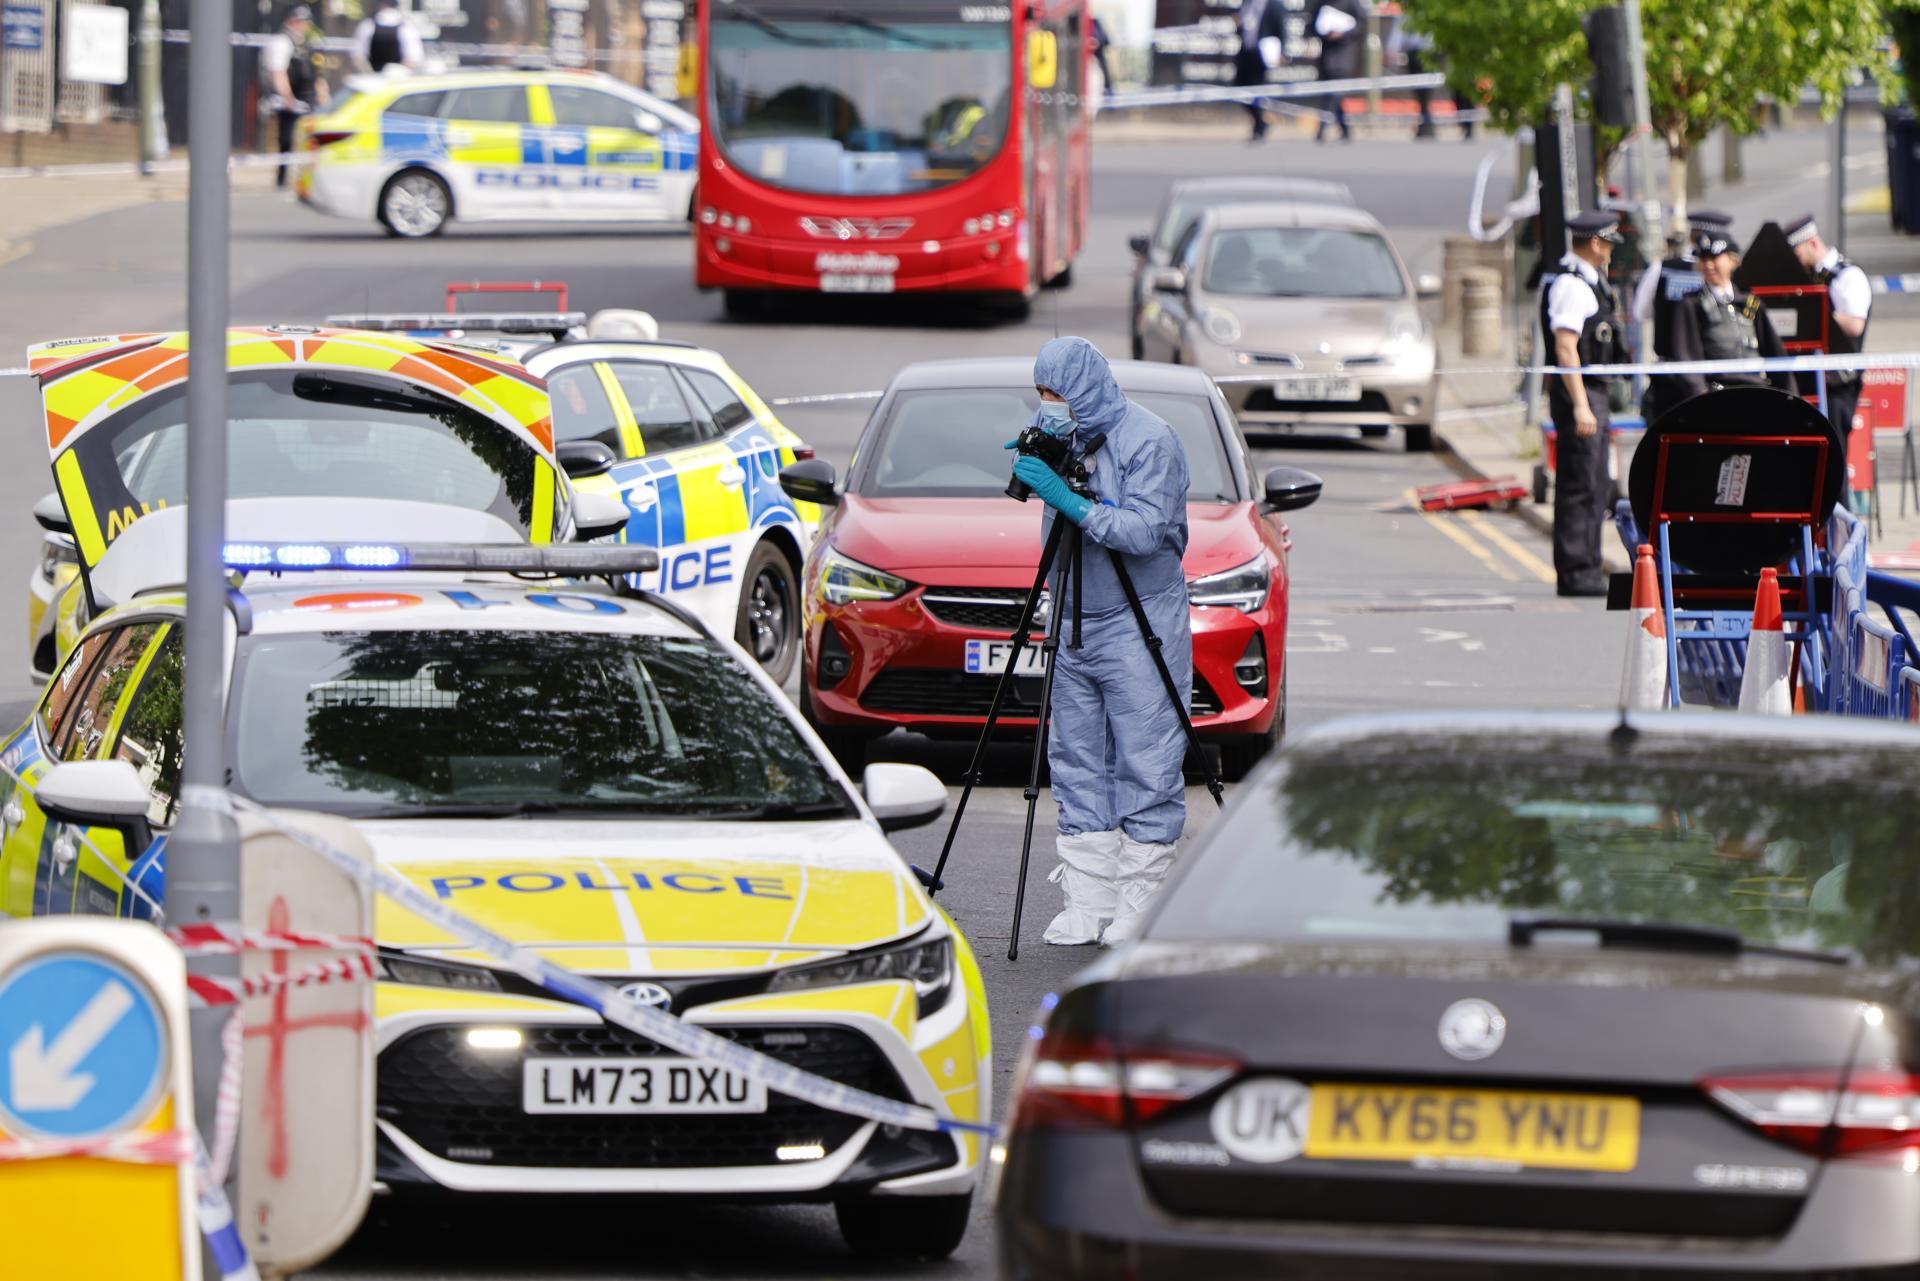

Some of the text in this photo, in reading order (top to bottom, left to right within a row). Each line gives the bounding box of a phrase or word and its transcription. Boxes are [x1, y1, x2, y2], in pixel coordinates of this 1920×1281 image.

[476, 171, 659, 191] POLICE
[431, 872, 794, 900] POLICE
[543, 1068, 653, 1105] LM73
[668, 1068, 749, 1105] DXU
[1231, 1092, 1304, 1140] UK
[1331, 1091, 1609, 1153] KY66 YNU
